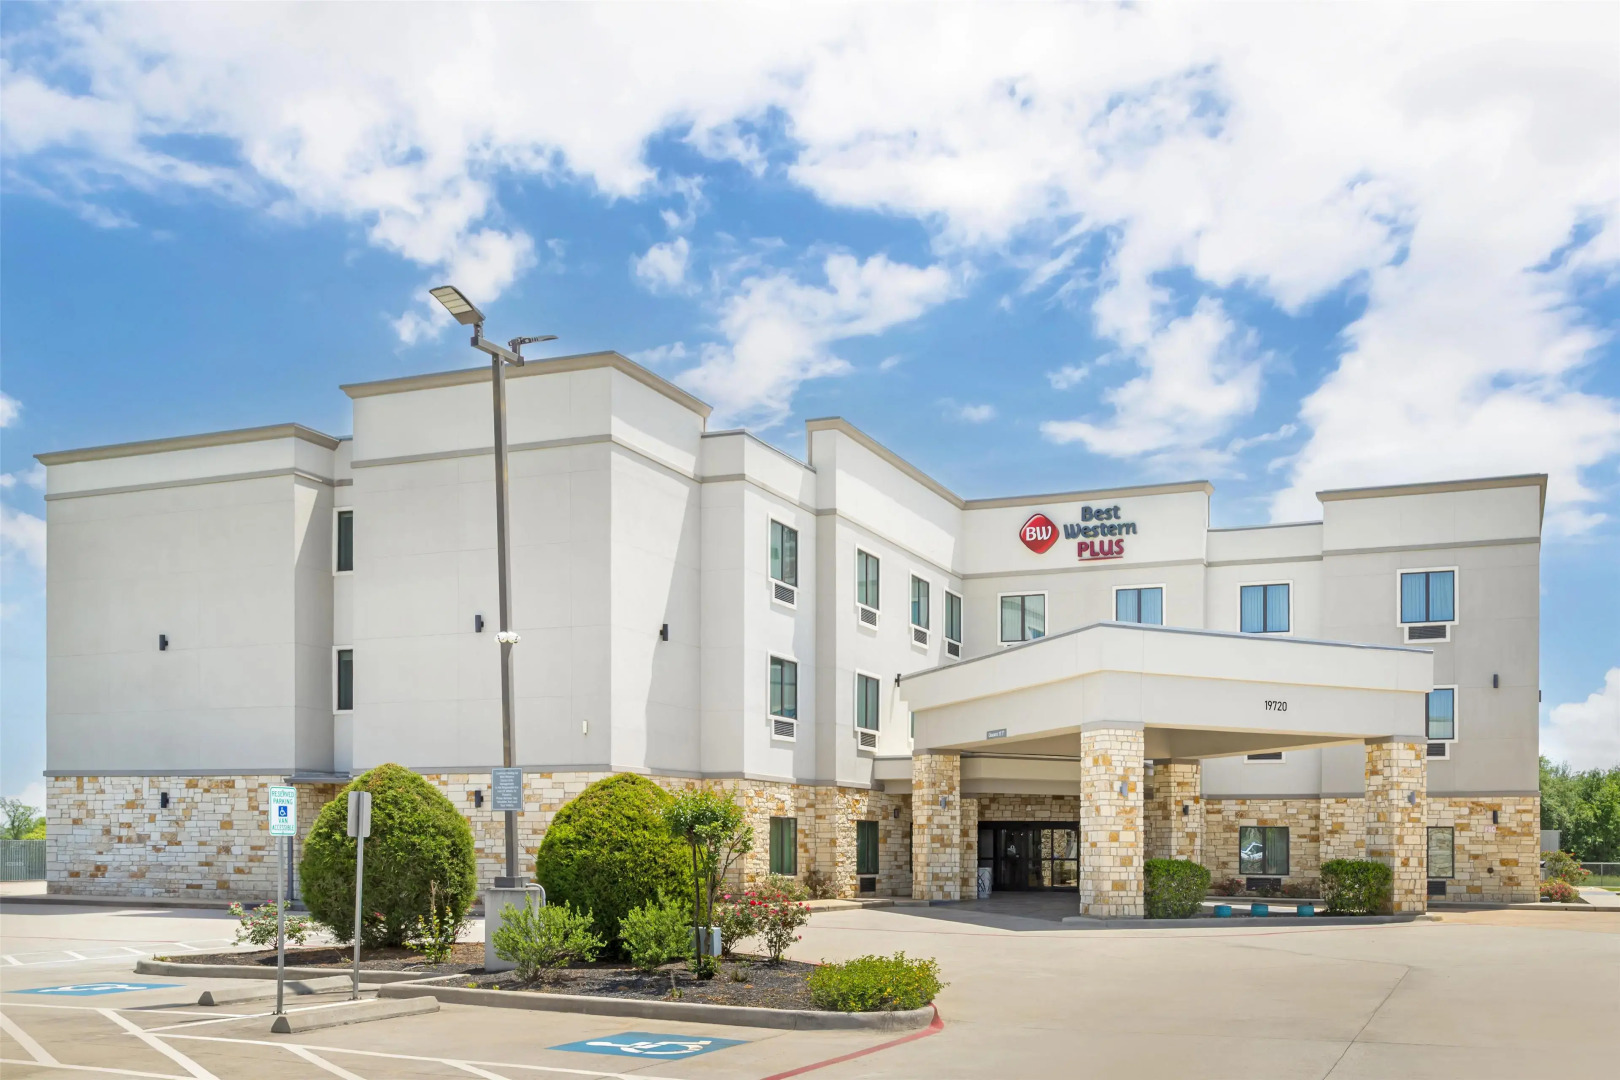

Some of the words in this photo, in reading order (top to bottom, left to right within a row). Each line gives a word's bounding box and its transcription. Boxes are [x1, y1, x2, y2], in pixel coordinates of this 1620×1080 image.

[1081, 505, 1121, 522] Best
[1026, 526, 1052, 541] BW
[1063, 522, 1137, 539] Western
[1077, 539, 1124, 558] PLUS
[1264, 700, 1288, 711] 19720
